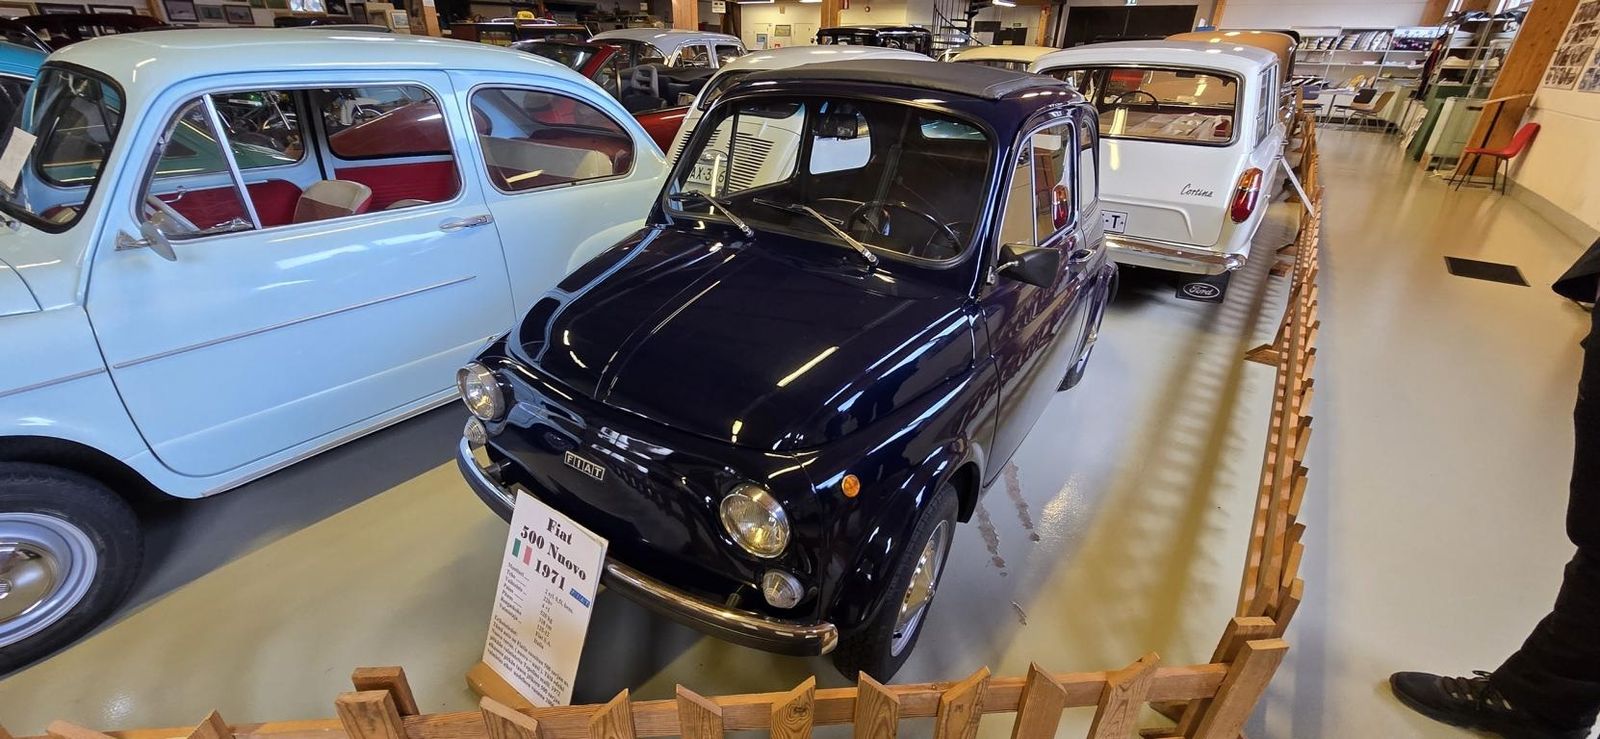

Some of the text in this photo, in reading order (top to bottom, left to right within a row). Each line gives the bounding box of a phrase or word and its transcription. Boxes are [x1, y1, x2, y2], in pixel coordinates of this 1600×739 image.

[1180, 183, 1214, 198] Cortina
[1188, 283, 1214, 296] Ford
[566, 452, 603, 478] FIAT
[546, 517, 573, 545] Fiat
[520, 524, 587, 581] 500 Nuovo
[534, 558, 566, 591] 1971
